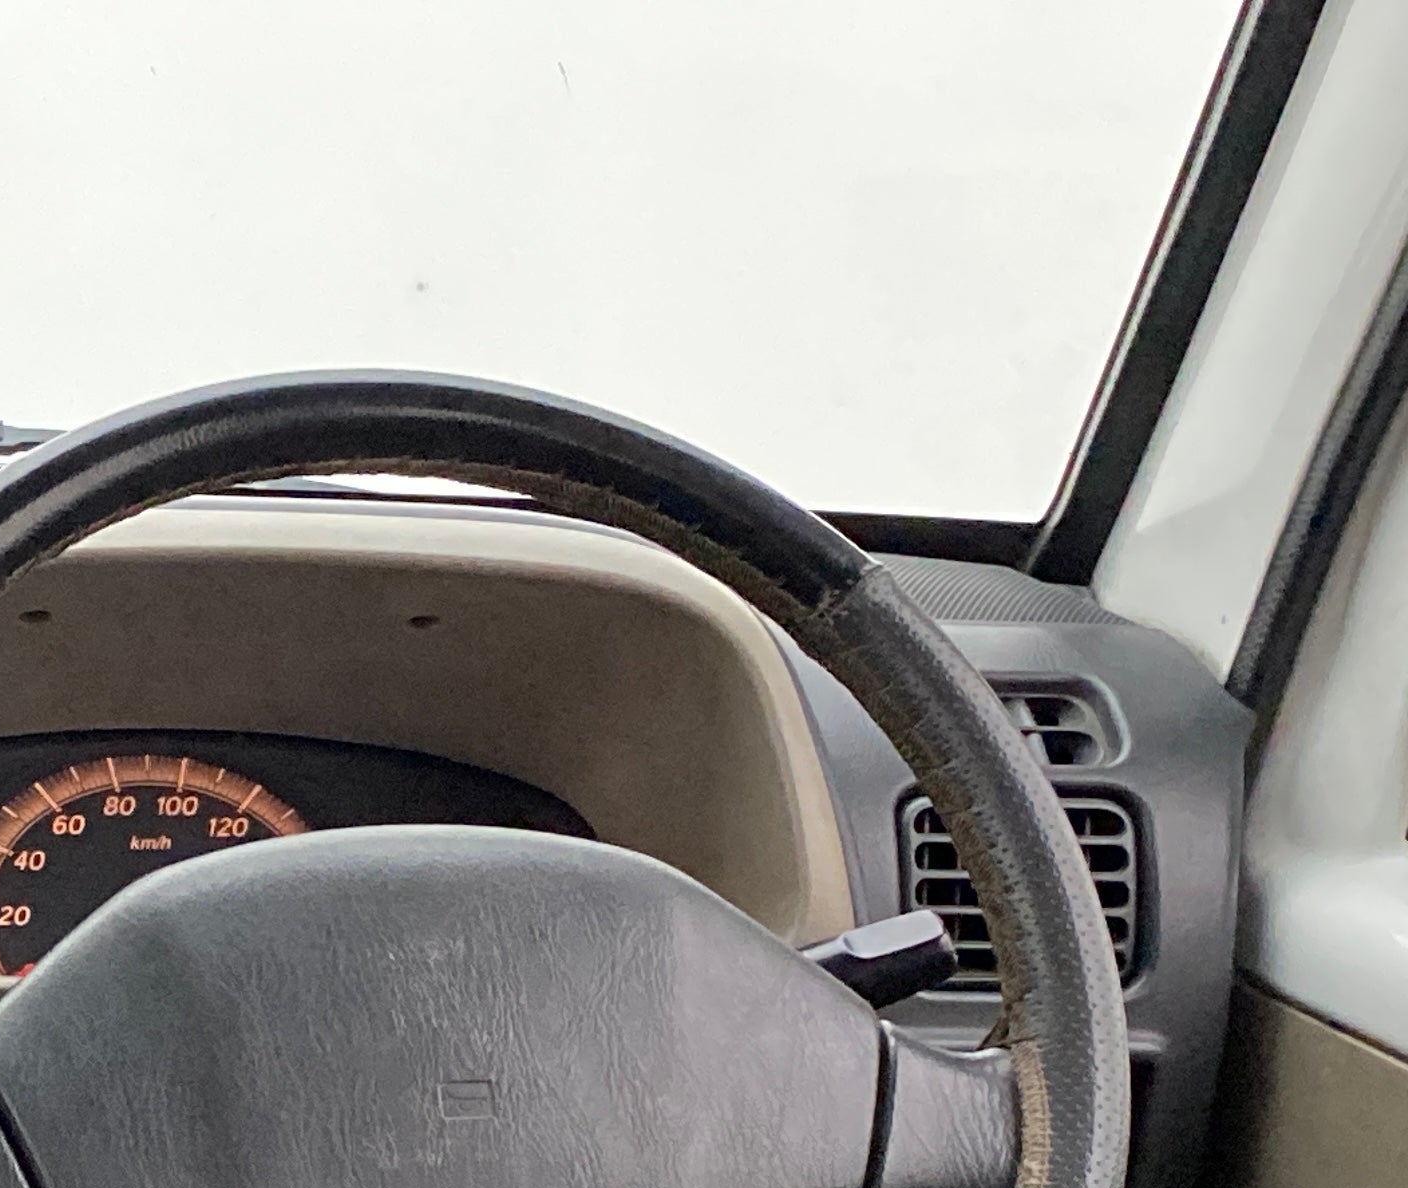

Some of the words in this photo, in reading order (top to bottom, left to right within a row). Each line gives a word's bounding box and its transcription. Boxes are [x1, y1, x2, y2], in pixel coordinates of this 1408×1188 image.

[103, 796, 136, 816] 80
[157, 796, 199, 816] 100
[52, 814, 86, 835] 60
[209, 817, 249, 837] 120
[130, 834, 172, 850] km/h
[14, 850, 46, 871] 40
